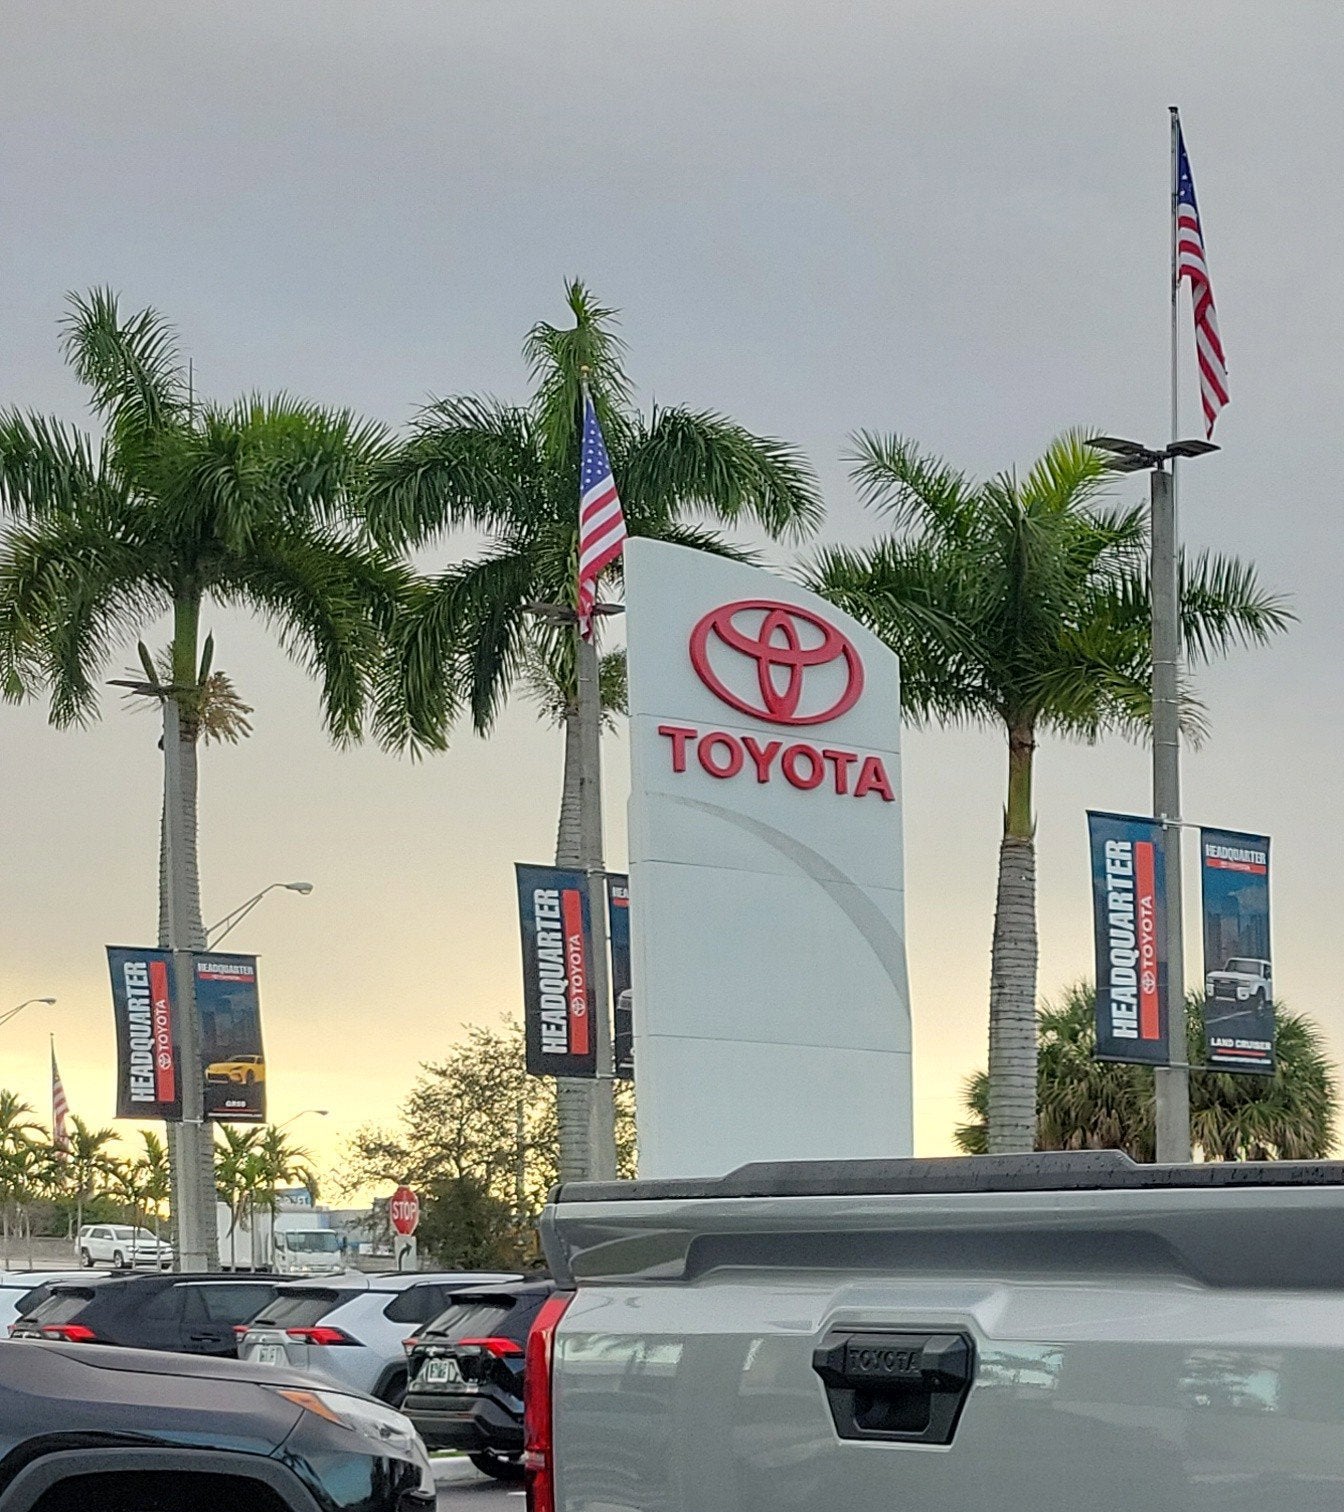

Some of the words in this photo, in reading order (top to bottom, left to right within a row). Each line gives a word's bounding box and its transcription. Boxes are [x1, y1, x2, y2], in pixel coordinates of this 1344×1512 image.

[658, 725, 895, 802] TOYOTA
[569, 934, 584, 993] TOYOTA
[1105, 840, 1139, 1039] HEADQUARTER
[1140, 896, 1154, 967] TOYOTA
[533, 888, 568, 1054] HEADQUARTER
[124, 962, 155, 1102] HEADQUARTER
[155, 1000, 170, 1050] TOYOTA
[393, 1202, 417, 1220] STOP
[849, 1348, 921, 1374] TOYOTA
